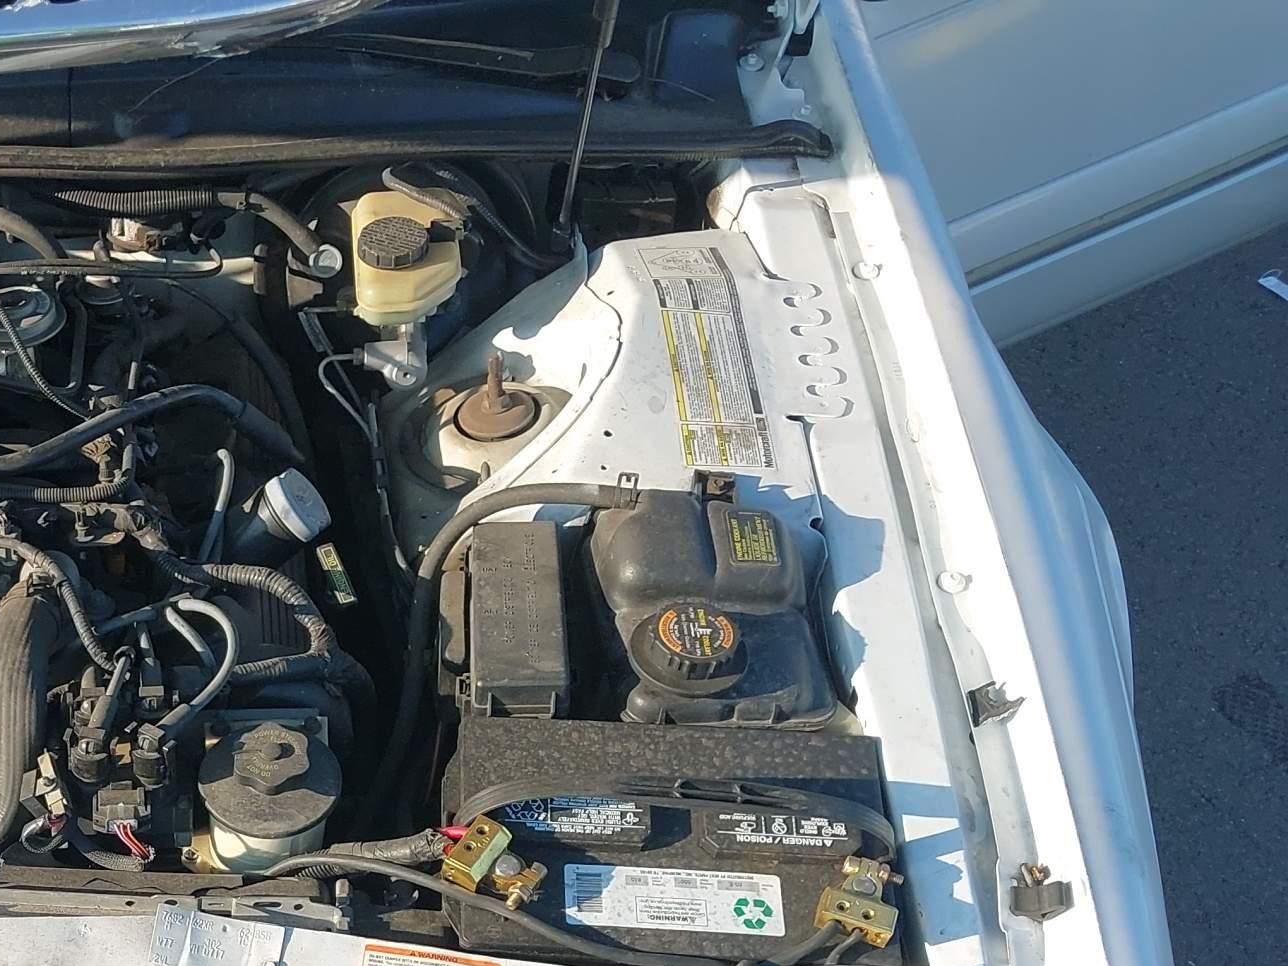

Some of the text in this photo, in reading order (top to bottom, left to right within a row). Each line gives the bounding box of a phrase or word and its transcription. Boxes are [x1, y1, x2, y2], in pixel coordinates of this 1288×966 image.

[758, 432, 775, 468] Motorcraft
[254, 729, 280, 739] POWER
[736, 834, 773, 843] POISON
[783, 837, 823, 846] DANGER
[417, 951, 459, 963] WARNING
